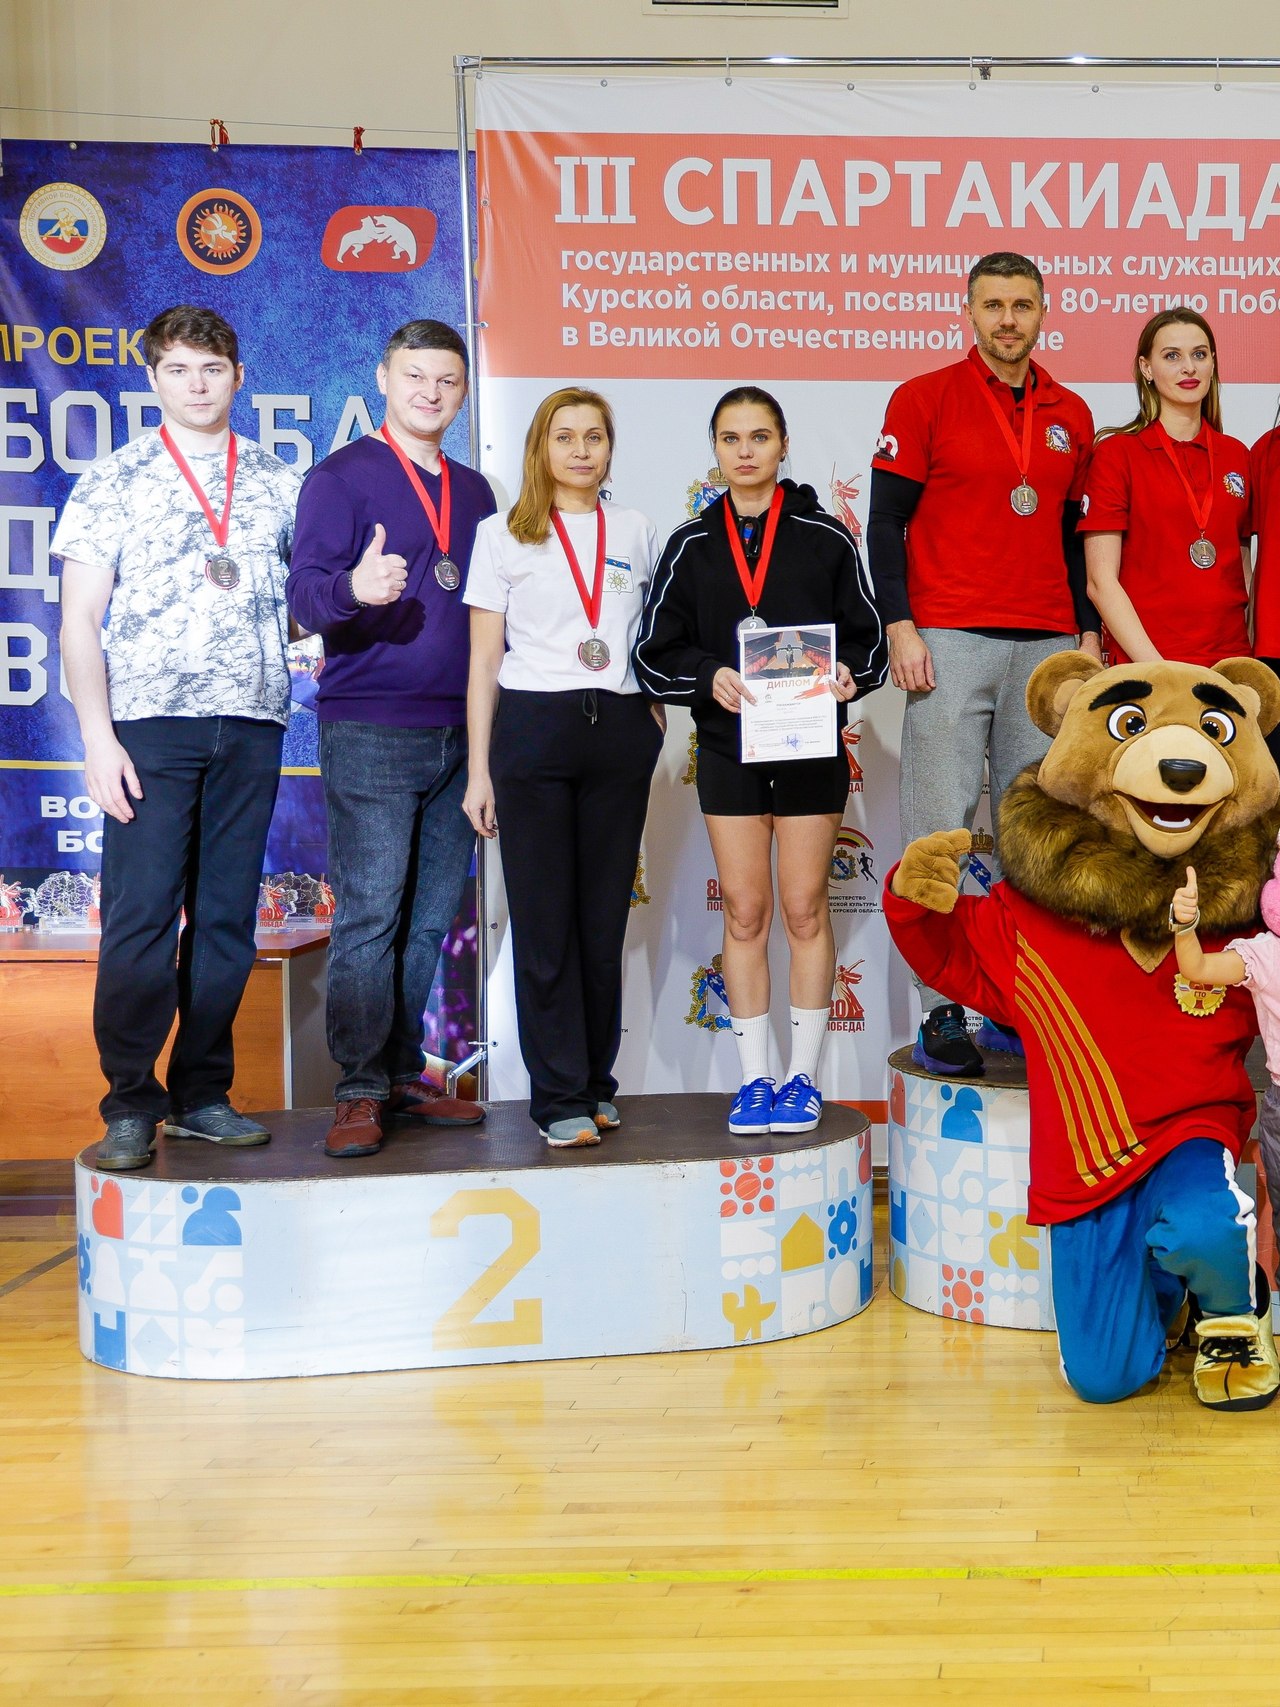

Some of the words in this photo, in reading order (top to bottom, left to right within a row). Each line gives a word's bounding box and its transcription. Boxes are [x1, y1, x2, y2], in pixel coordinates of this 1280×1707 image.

[554, 156, 636, 224] III
[561, 249, 831, 276] государственных
[840, 253, 858, 273] и
[868, 253, 1113, 279] мунициьных
[562, 282, 692, 314] Курской
[702, 284, 835, 316] области,
[1060, 287, 1208, 314] 80-летию
[0, 325, 149, 366] РОЕК
[562, 325, 579, 346] в
[589, 320, 721, 348] Великой
[730, 322, 964, 351] Отечественной
[766, 678, 811, 691] ДИПЛОМ
[707, 879, 722, 897] 8
[429, 1187, 543, 1351] 2
